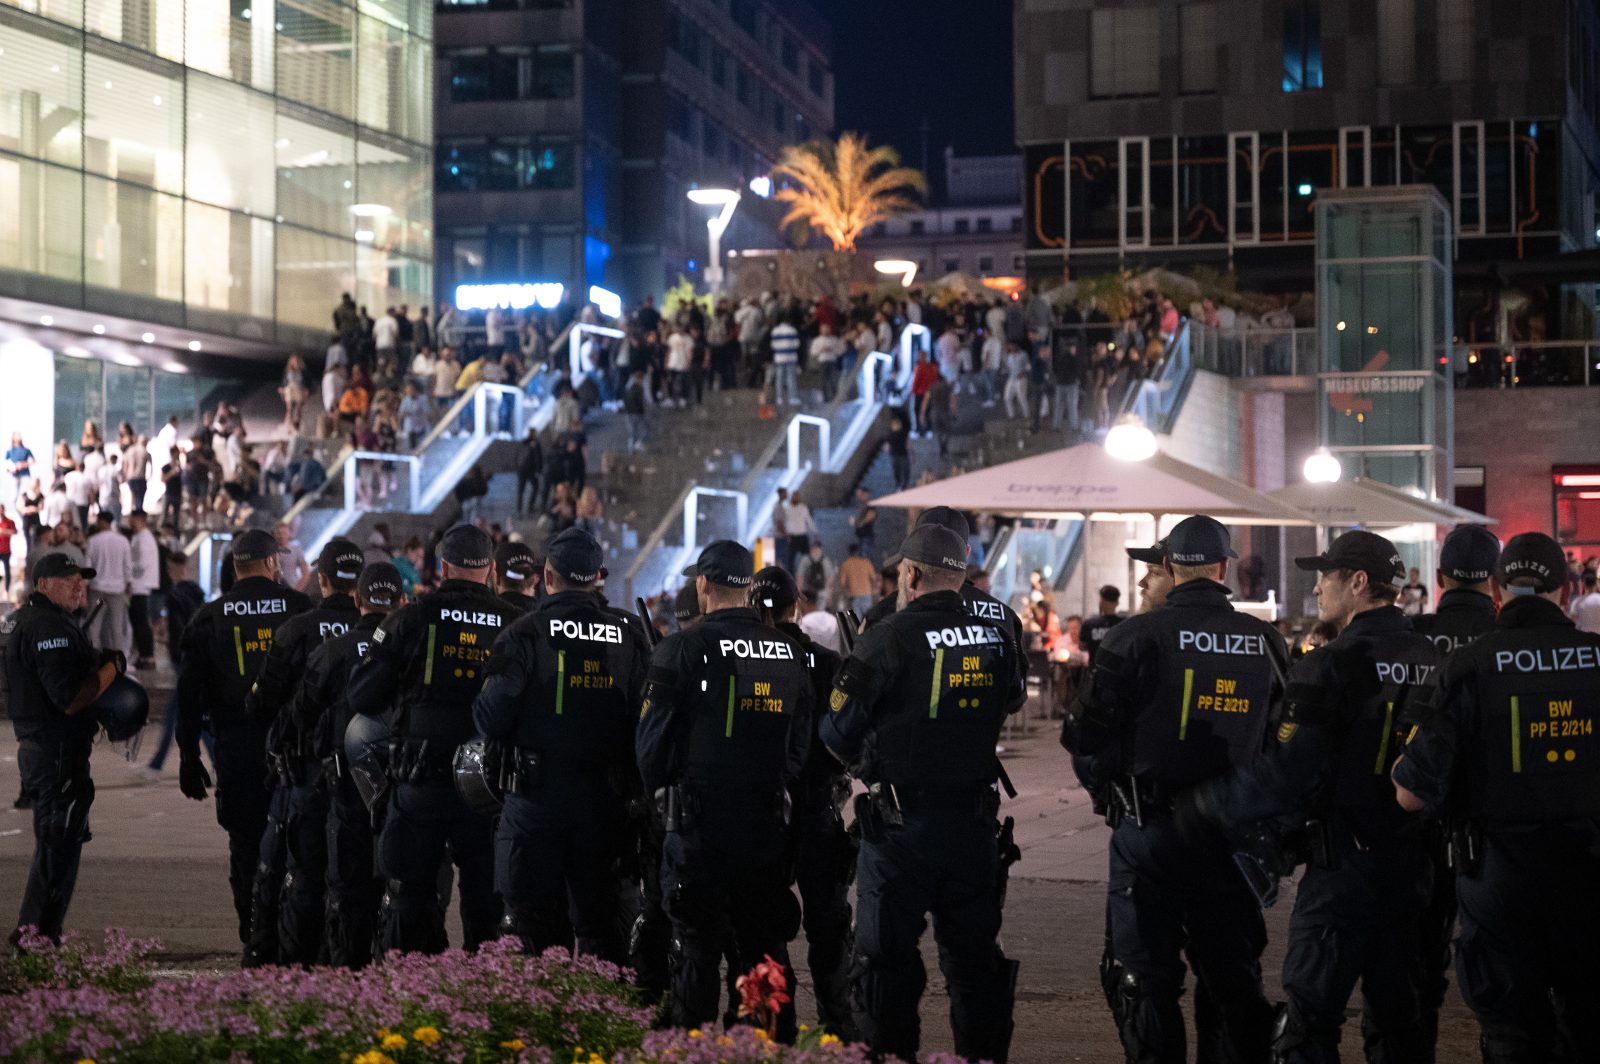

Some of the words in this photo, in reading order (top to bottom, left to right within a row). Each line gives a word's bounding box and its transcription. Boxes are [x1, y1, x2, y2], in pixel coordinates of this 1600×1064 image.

[1325, 377, 1424, 393] MUSEUMSSHOP
[942, 556, 967, 570] POLIZE
[1505, 560, 1550, 577] POLIZEI
[1453, 569, 1488, 578] POLIZEI
[223, 599, 287, 616] POLIZEI
[440, 608, 502, 627] POLIZEI
[257, 628, 272, 640] BW
[459, 631, 477, 645] BW
[549, 619, 623, 644] POLIZEI
[925, 625, 1004, 650] POLIZEI
[37, 637, 69, 651] POLIZEI
[246, 641, 259, 652] PP
[260, 640, 267, 651] E
[719, 638, 794, 660] POLIZEI
[1179, 630, 1265, 655] POLIZEI
[443, 645, 456, 658] PP
[457, 646, 465, 659] E
[1496, 646, 1600, 673] POLIZEI
[583, 660, 600, 673] BW
[962, 656, 980, 671] BW
[570, 675, 583, 688] PP
[584, 675, 591, 688] E
[949, 673, 962, 687] PP
[1215, 678, 1237, 694] BW
[754, 681, 771, 697] BW
[740, 698, 752, 711] PP
[754, 698, 761, 711] E
[762, 698, 783, 713] 2/212
[1197, 695, 1213, 710] PP
[1214, 697, 1222, 711] E
[1223, 698, 1249, 713] 2/213
[1549, 700, 1573, 718] BW
[1530, 722, 1547, 738] PP
[1550, 721, 1559, 737] E
[1561, 719, 1593, 736] 2/214
